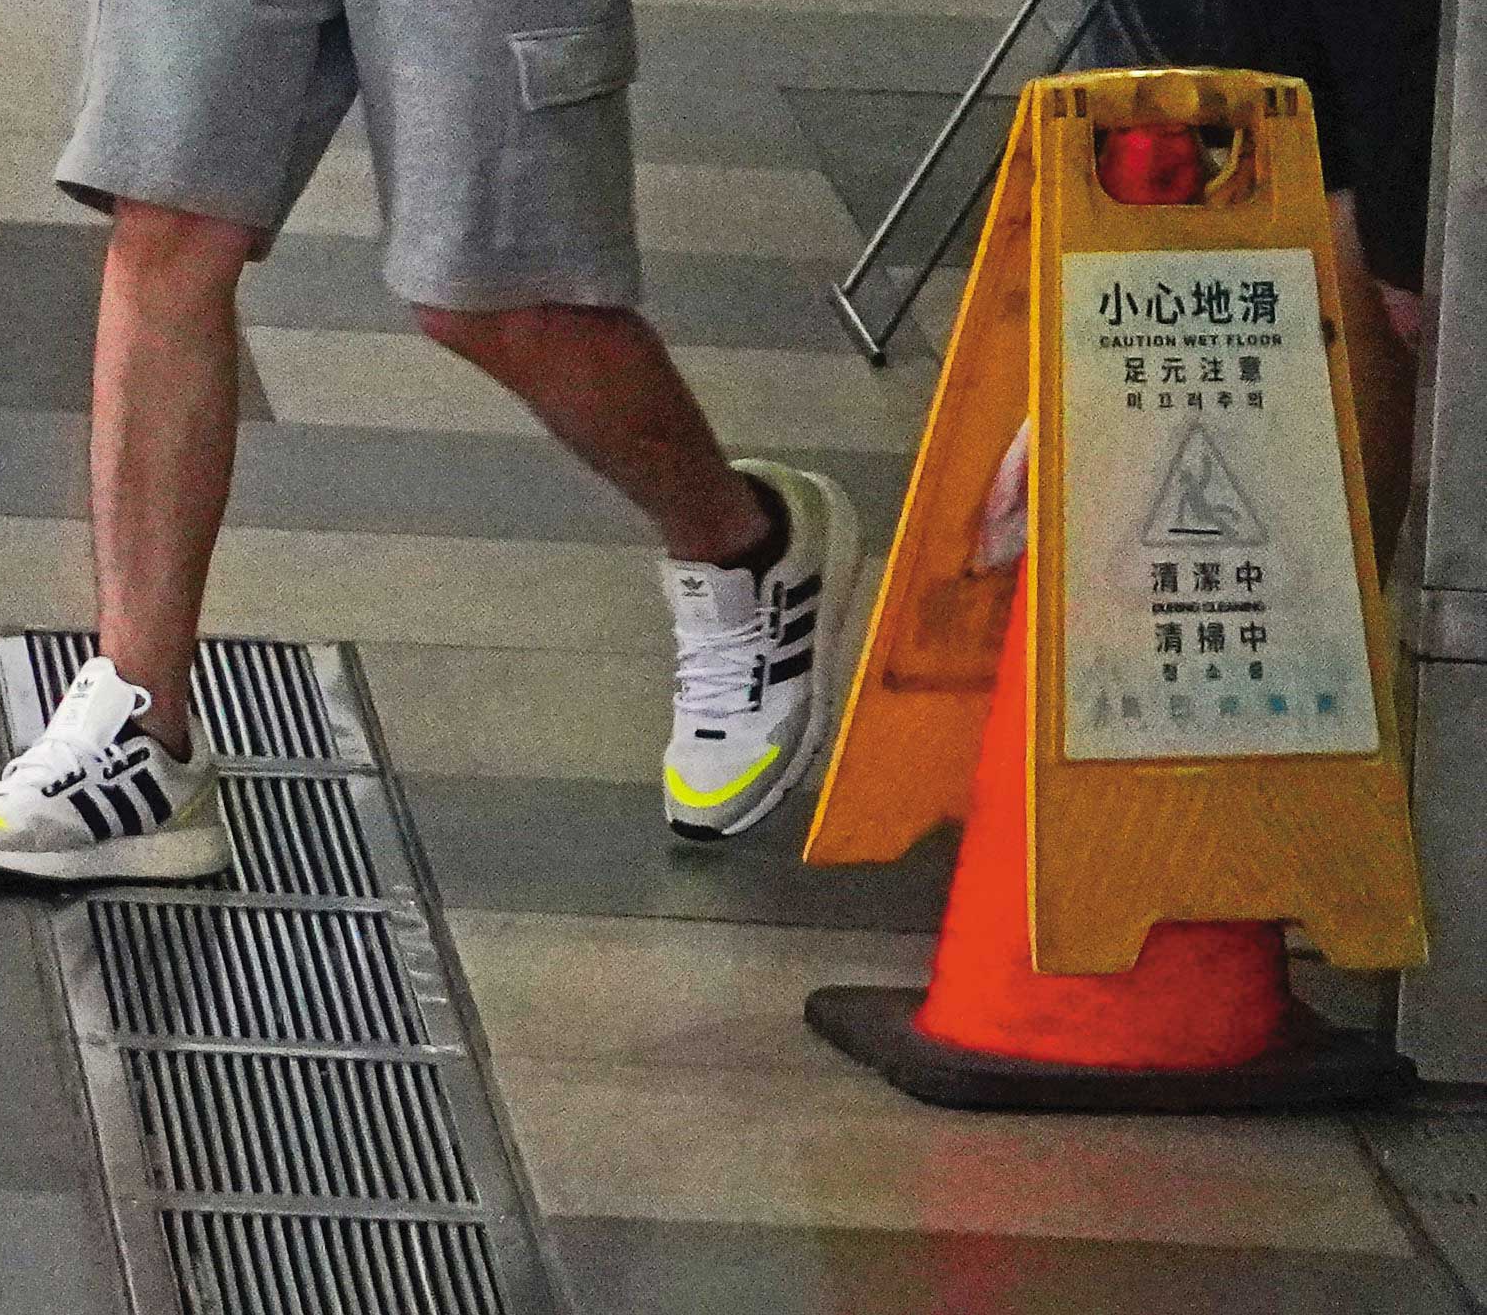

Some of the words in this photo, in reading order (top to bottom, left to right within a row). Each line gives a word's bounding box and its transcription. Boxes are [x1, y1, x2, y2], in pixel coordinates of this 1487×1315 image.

[1098, 280, 1279, 326] 小心地滑
[1099, 334, 1177, 348] CAUTION
[1183, 334, 1219, 347] WET
[1226, 333, 1283, 347] FLOOR
[1124, 356, 1262, 385] 足元注意
[1151, 561, 1263, 593] 清潔中
[1155, 621, 1268, 654] 清掃中
